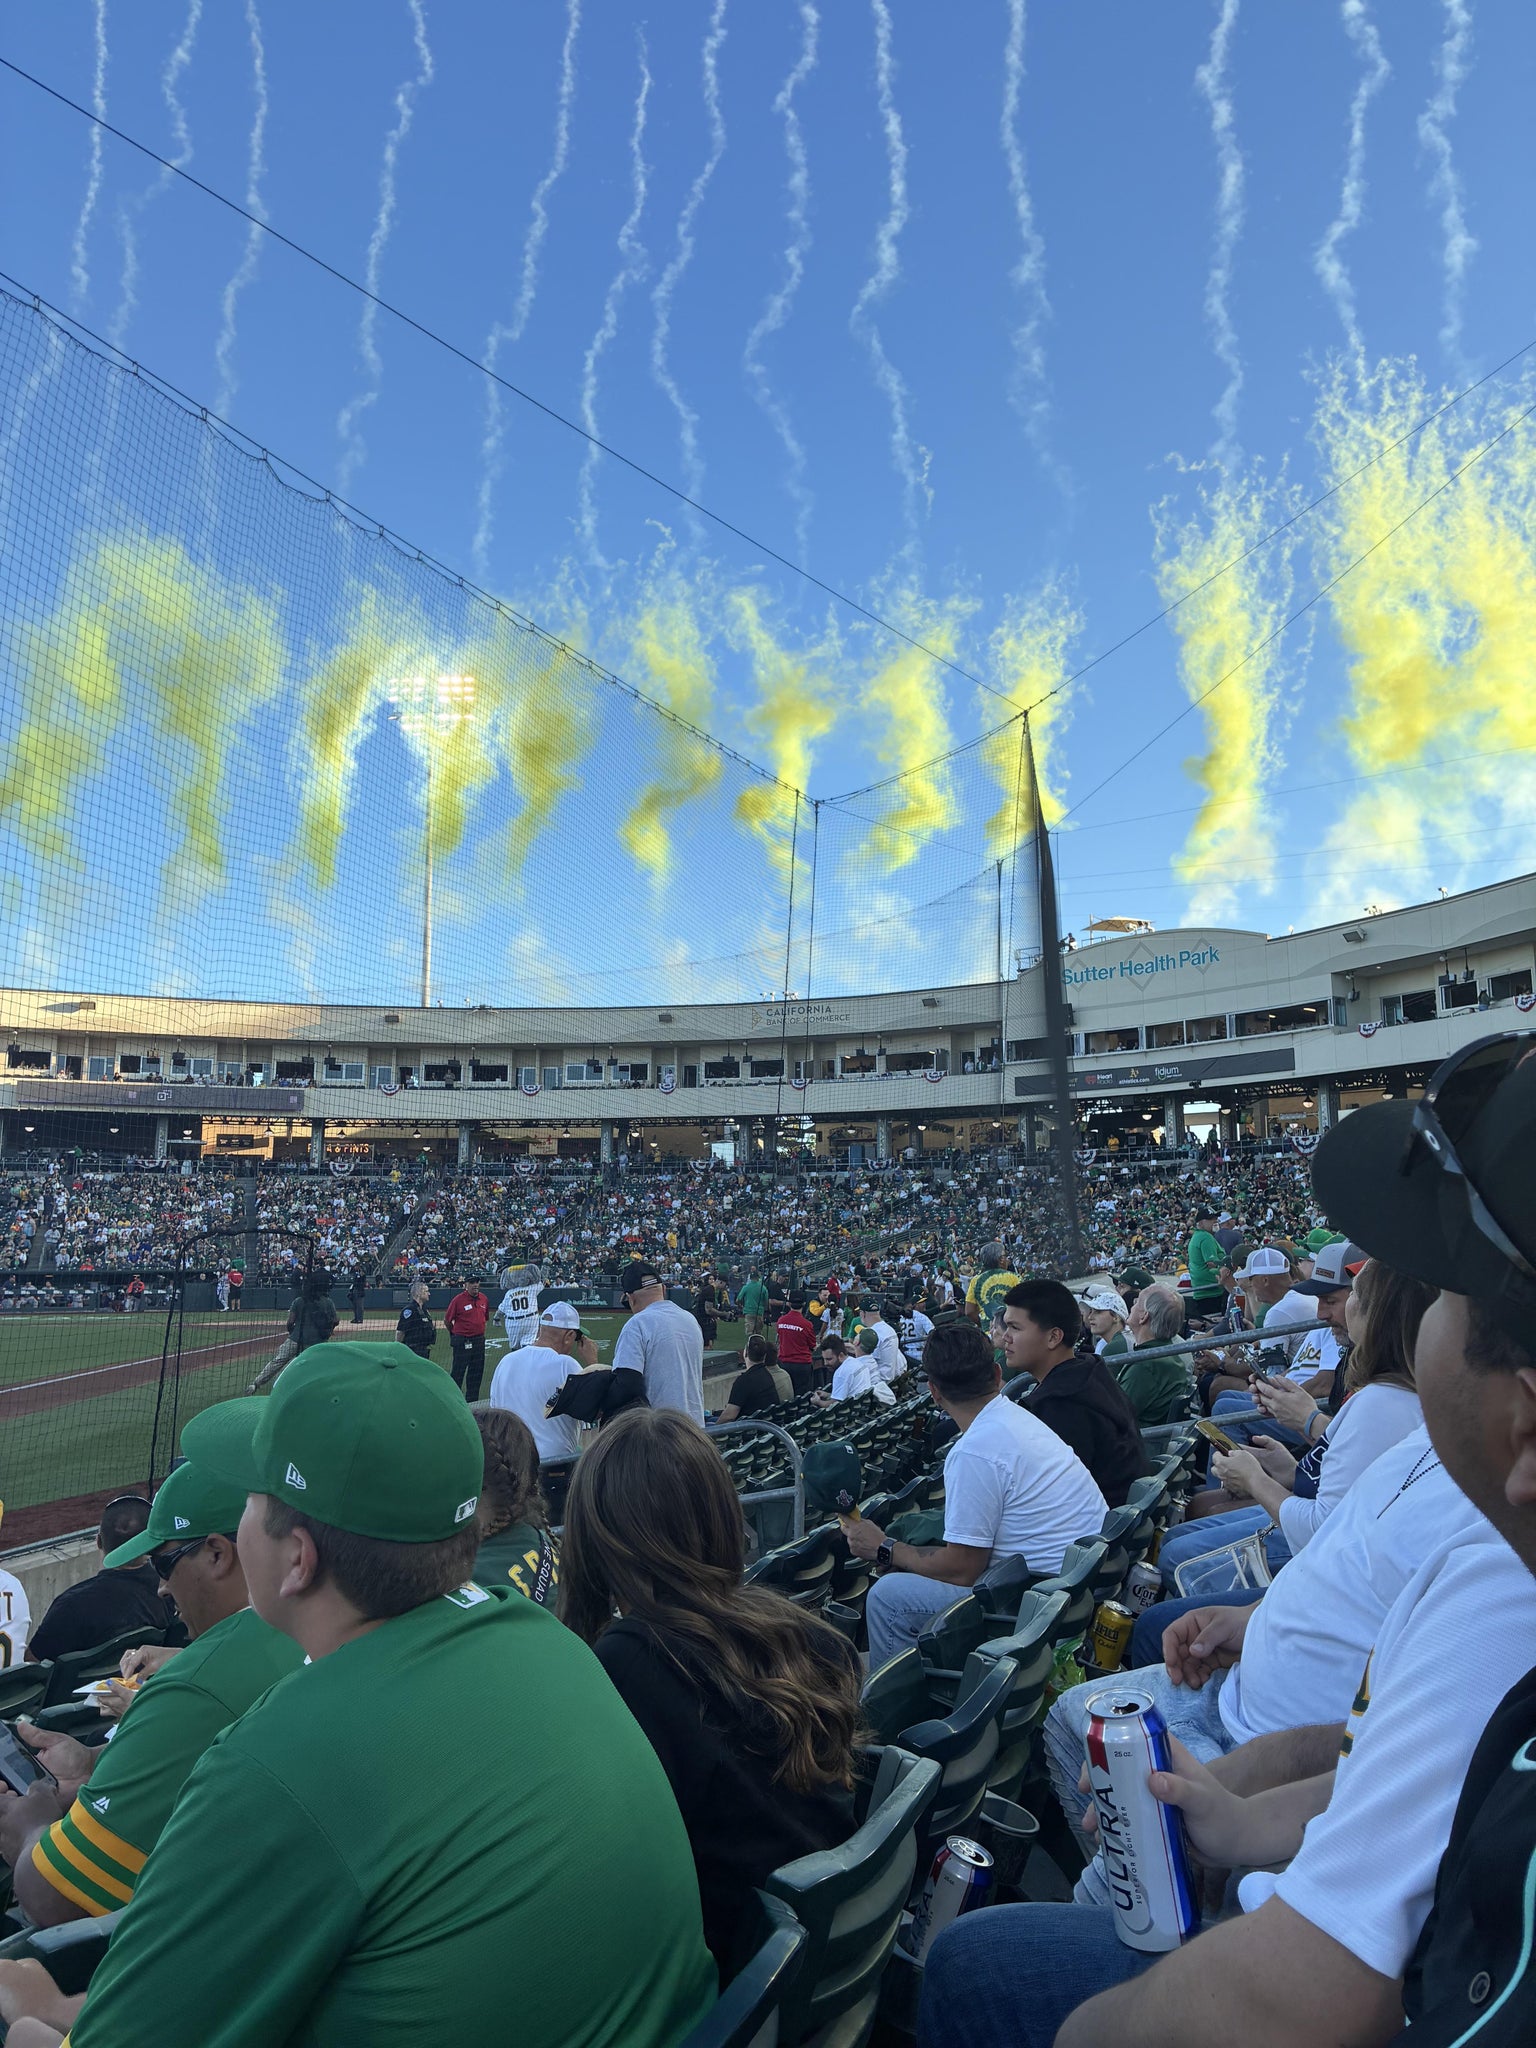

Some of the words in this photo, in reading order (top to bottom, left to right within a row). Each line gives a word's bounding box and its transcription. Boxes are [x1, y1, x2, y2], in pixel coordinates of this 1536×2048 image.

[1062, 965, 1116, 985] Sutter
[1119, 953, 1176, 977] Health
[1179, 945, 1220, 968] Park
[766, 1005, 832, 1017] CALIFORNIA
[790, 1017, 800, 1025] OF
[803, 1013, 851, 1024] COMMERCE
[511, 1296, 529, 1312] 00
[778, 1323, 804, 1332] SECURITY
[902, 1322, 917, 1338] 22
[534, 1559, 551, 1602] SQUAD
[1095, 1783, 1134, 1912] ULTRA
